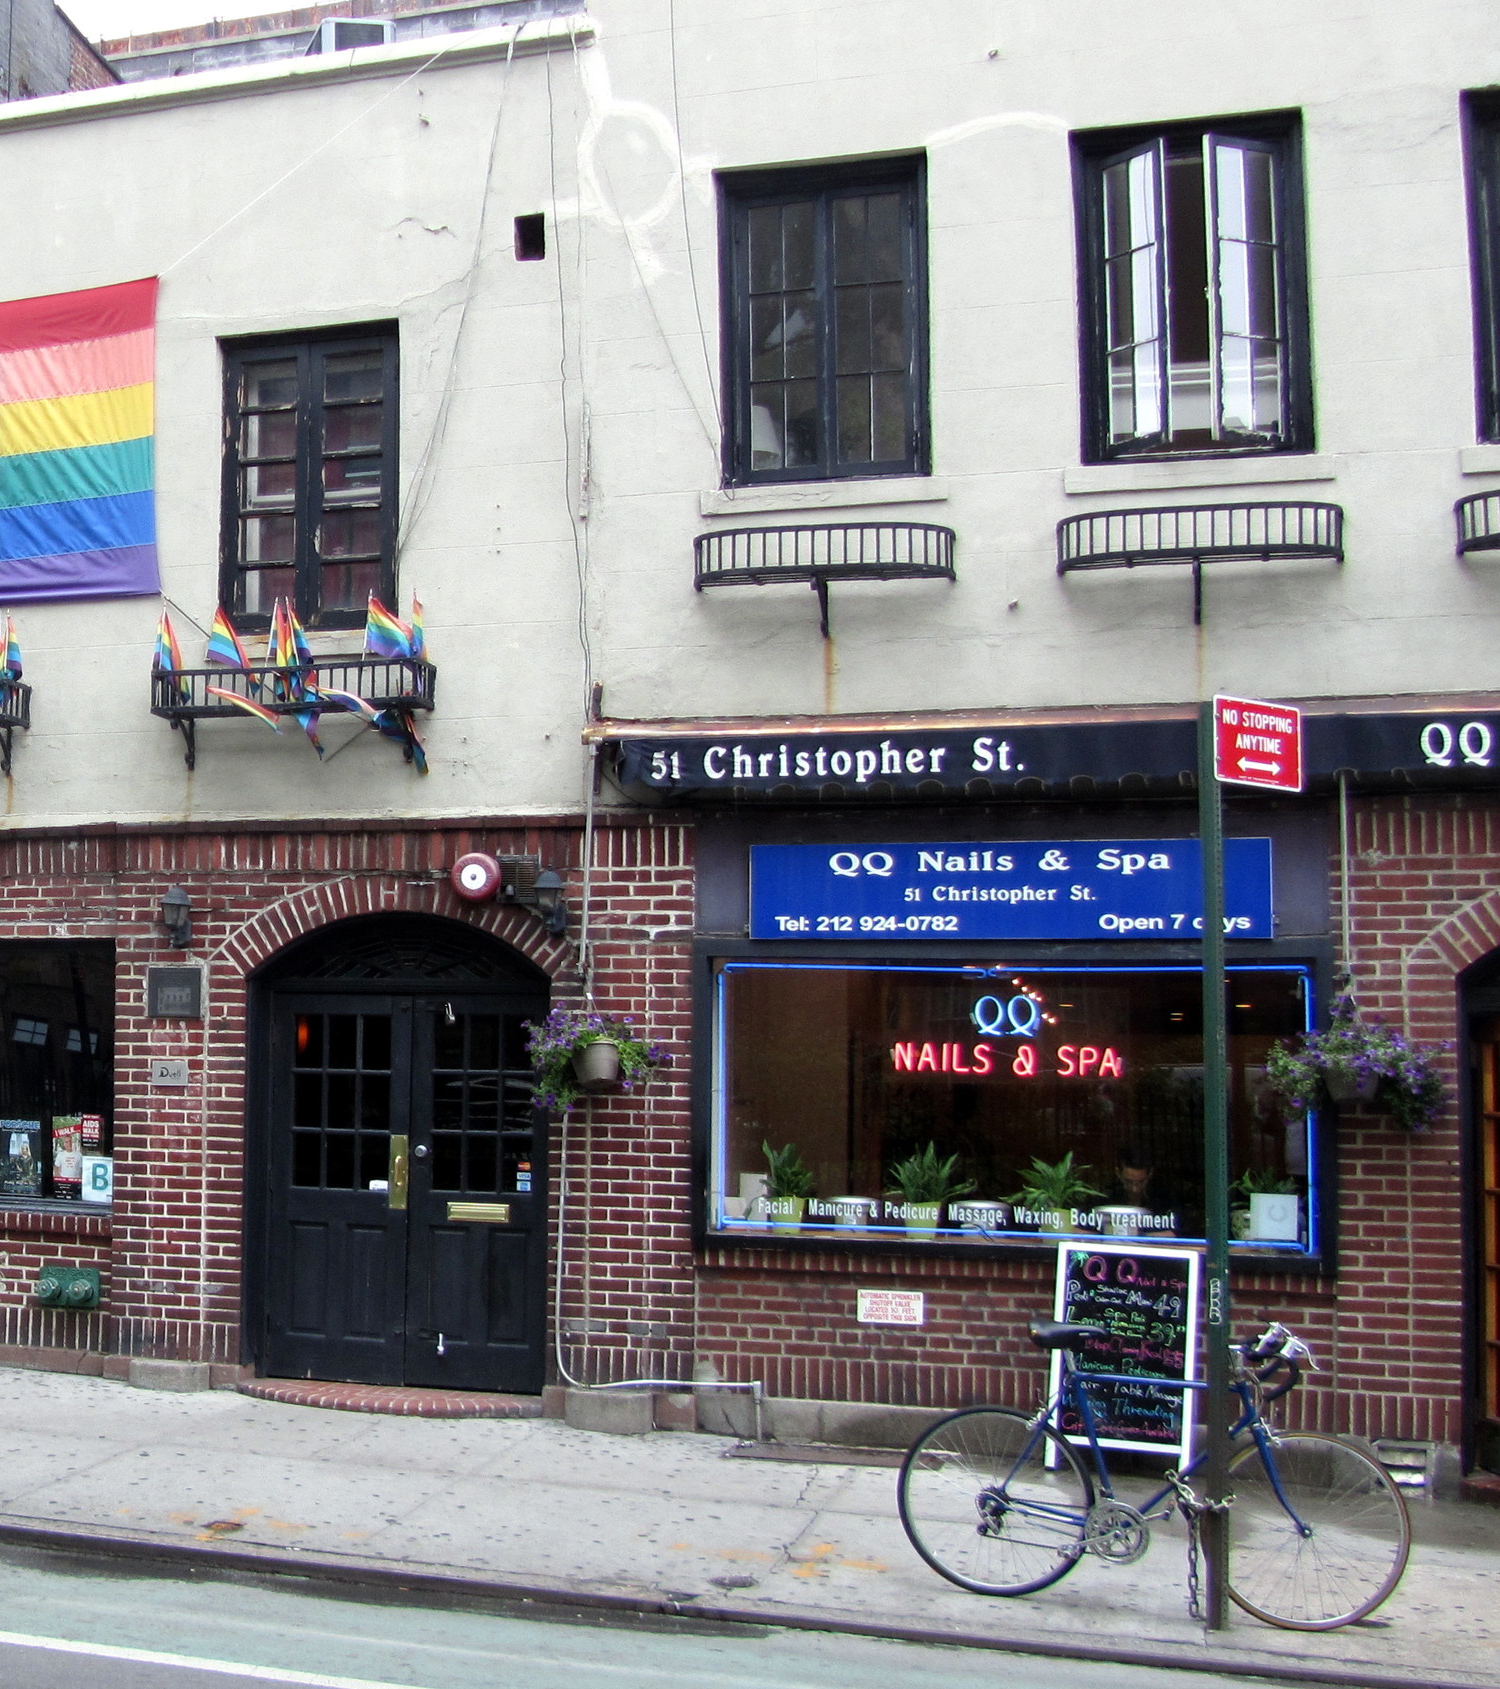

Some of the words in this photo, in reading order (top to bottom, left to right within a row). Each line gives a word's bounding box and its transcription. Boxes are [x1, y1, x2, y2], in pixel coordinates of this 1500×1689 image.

[1222, 708, 1238, 725] NO
[1242, 711, 1293, 734] STOPPING
[1235, 733, 1282, 755] ANYTIME
[1420, 721, 1491, 767] QQ
[651, 750, 681, 780] 51
[703, 739, 947, 783] Christopher
[971, 736, 1025, 772] St.
[828, 851, 894, 878] QQ
[917, 851, 1014, 872] Nails
[1038, 849, 1071, 872] &
[1096, 848, 1171, 875] Spa
[903, 887, 921, 902] 51
[932, 884, 1057, 905] Christopher
[1069, 884, 1097, 901] St.
[774, 916, 810, 932] Tel:
[816, 915, 853, 932] 212
[859, 915, 959, 932] 924-0782
[1098, 913, 1164, 934] Open
[1170, 914, 1185, 929] 7
[1192, 914, 1251, 933] dys
[974, 995, 1037, 1037] QQ
[894, 1042, 992, 1074] NAILS
[1012, 1045, 1035, 1076] &
[1056, 1046, 1120, 1077] SPA
[82, 1120, 100, 1128] AIDS
[82, 1127, 100, 1135] WALK
[91, 1163, 109, 1191] B
[808, 1198, 863, 1217] Manicure
[868, 1201, 878, 1218] &
[884, 1201, 939, 1220] Pedicure
[948, 1203, 1007, 1226] Massage,
[1012, 1205, 1064, 1229] Waxing,
[1070, 1208, 1103, 1230] Body
[1110, 1211, 1175, 1229] treatment
